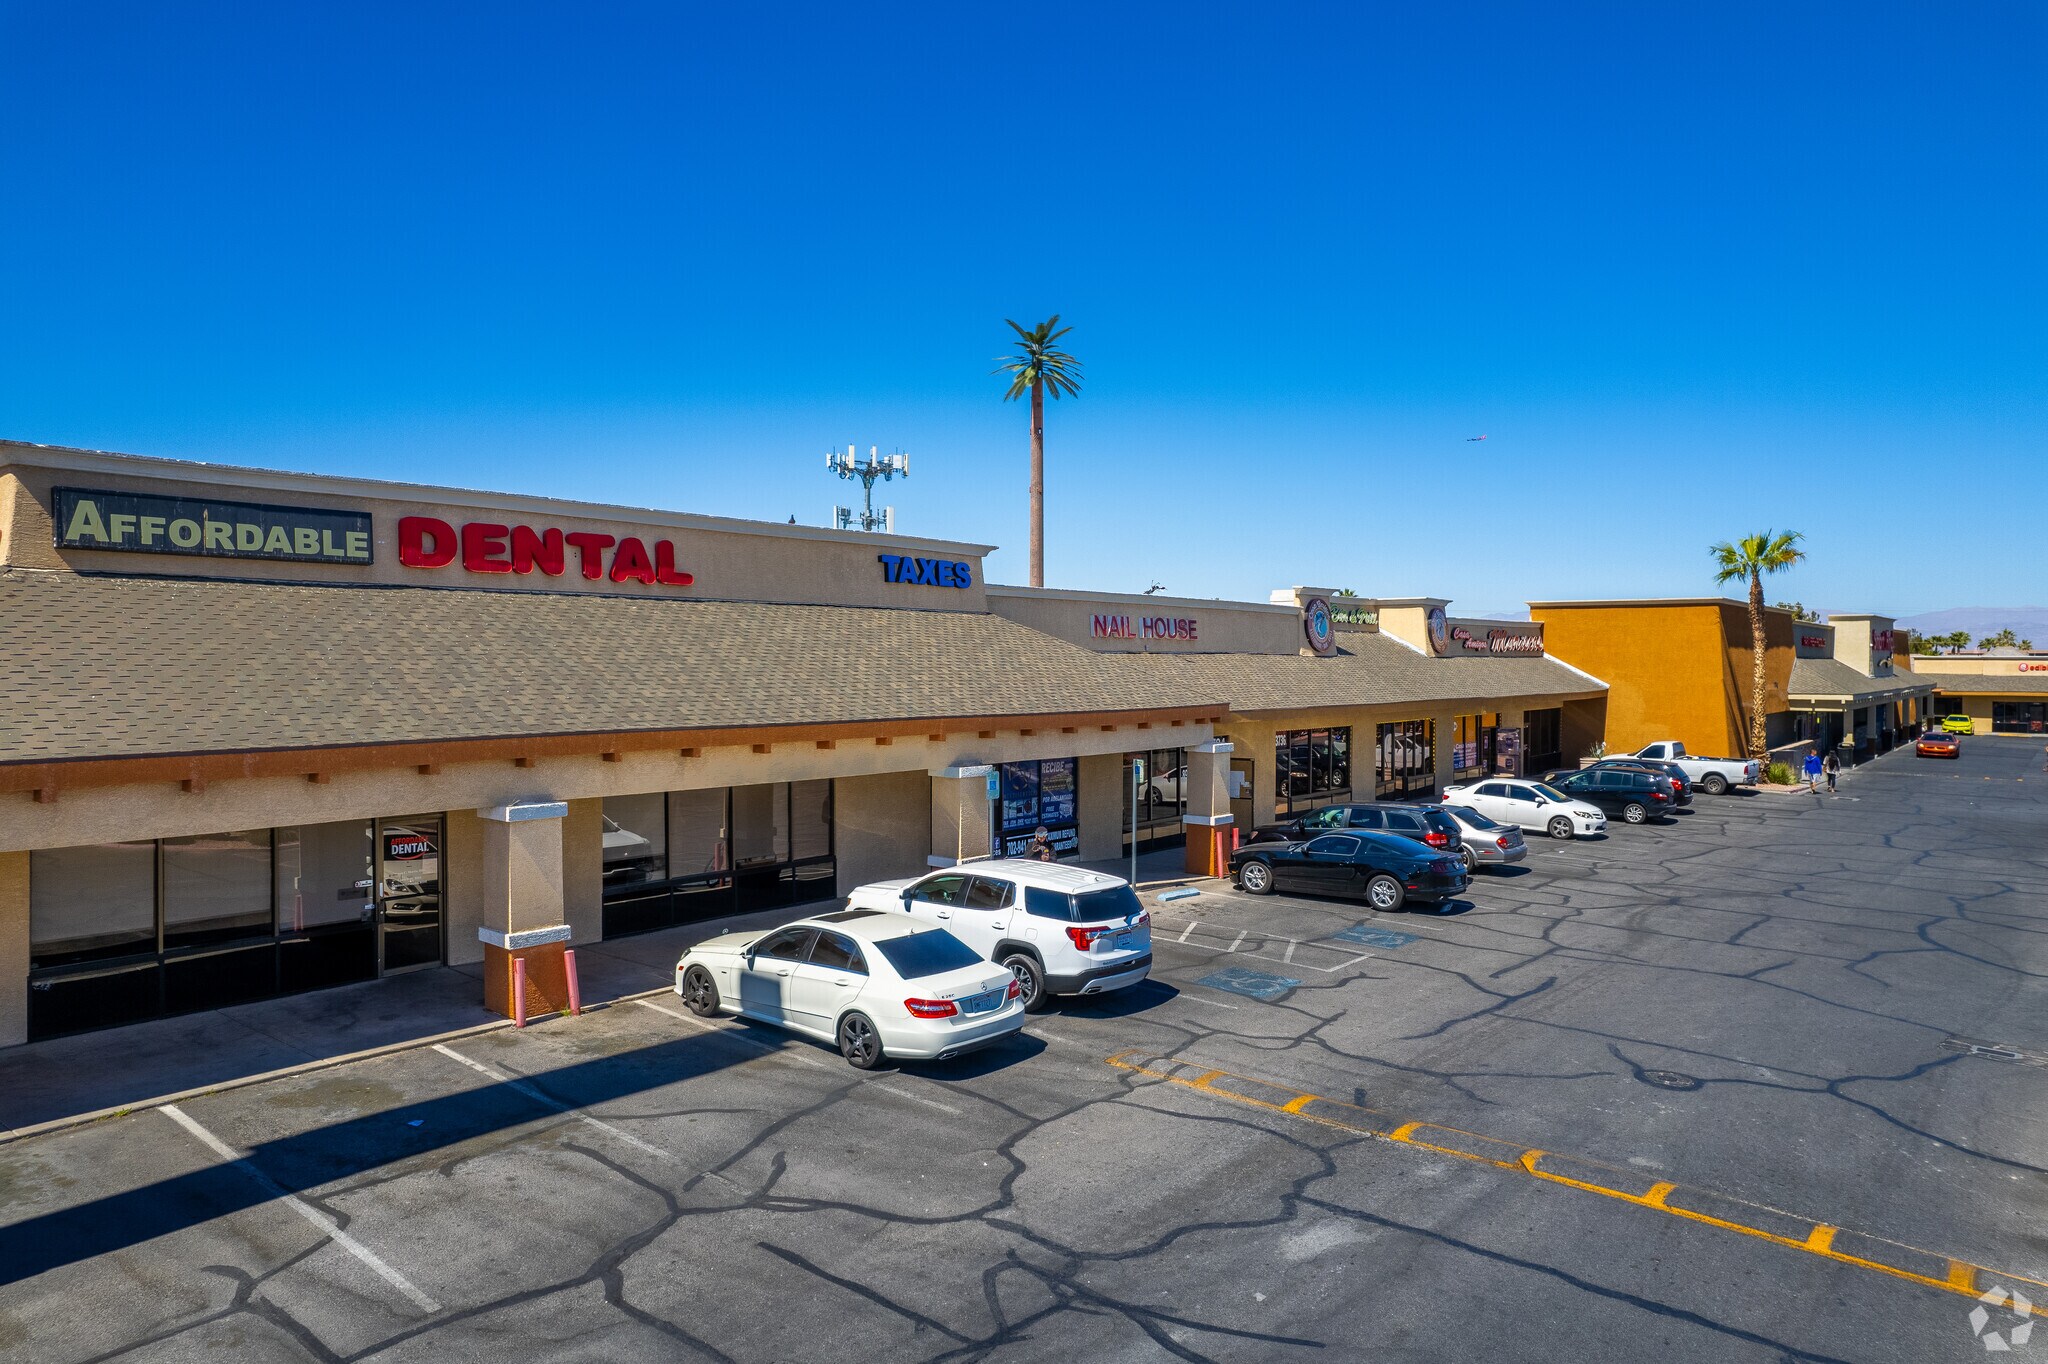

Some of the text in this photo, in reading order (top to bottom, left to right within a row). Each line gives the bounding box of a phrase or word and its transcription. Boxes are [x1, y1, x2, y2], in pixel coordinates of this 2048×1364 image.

[65, 499, 370, 559] AFFORDABLE
[398, 515, 694, 586] DENTAL
[878, 554, 972, 589] TAXES
[1090, 614, 1198, 641] NAIL HOUSE
[1452, 627, 1471, 641] Casa
[1041, 761, 1065, 774] RECIBE
[391, 842, 430, 855] DENTAL
